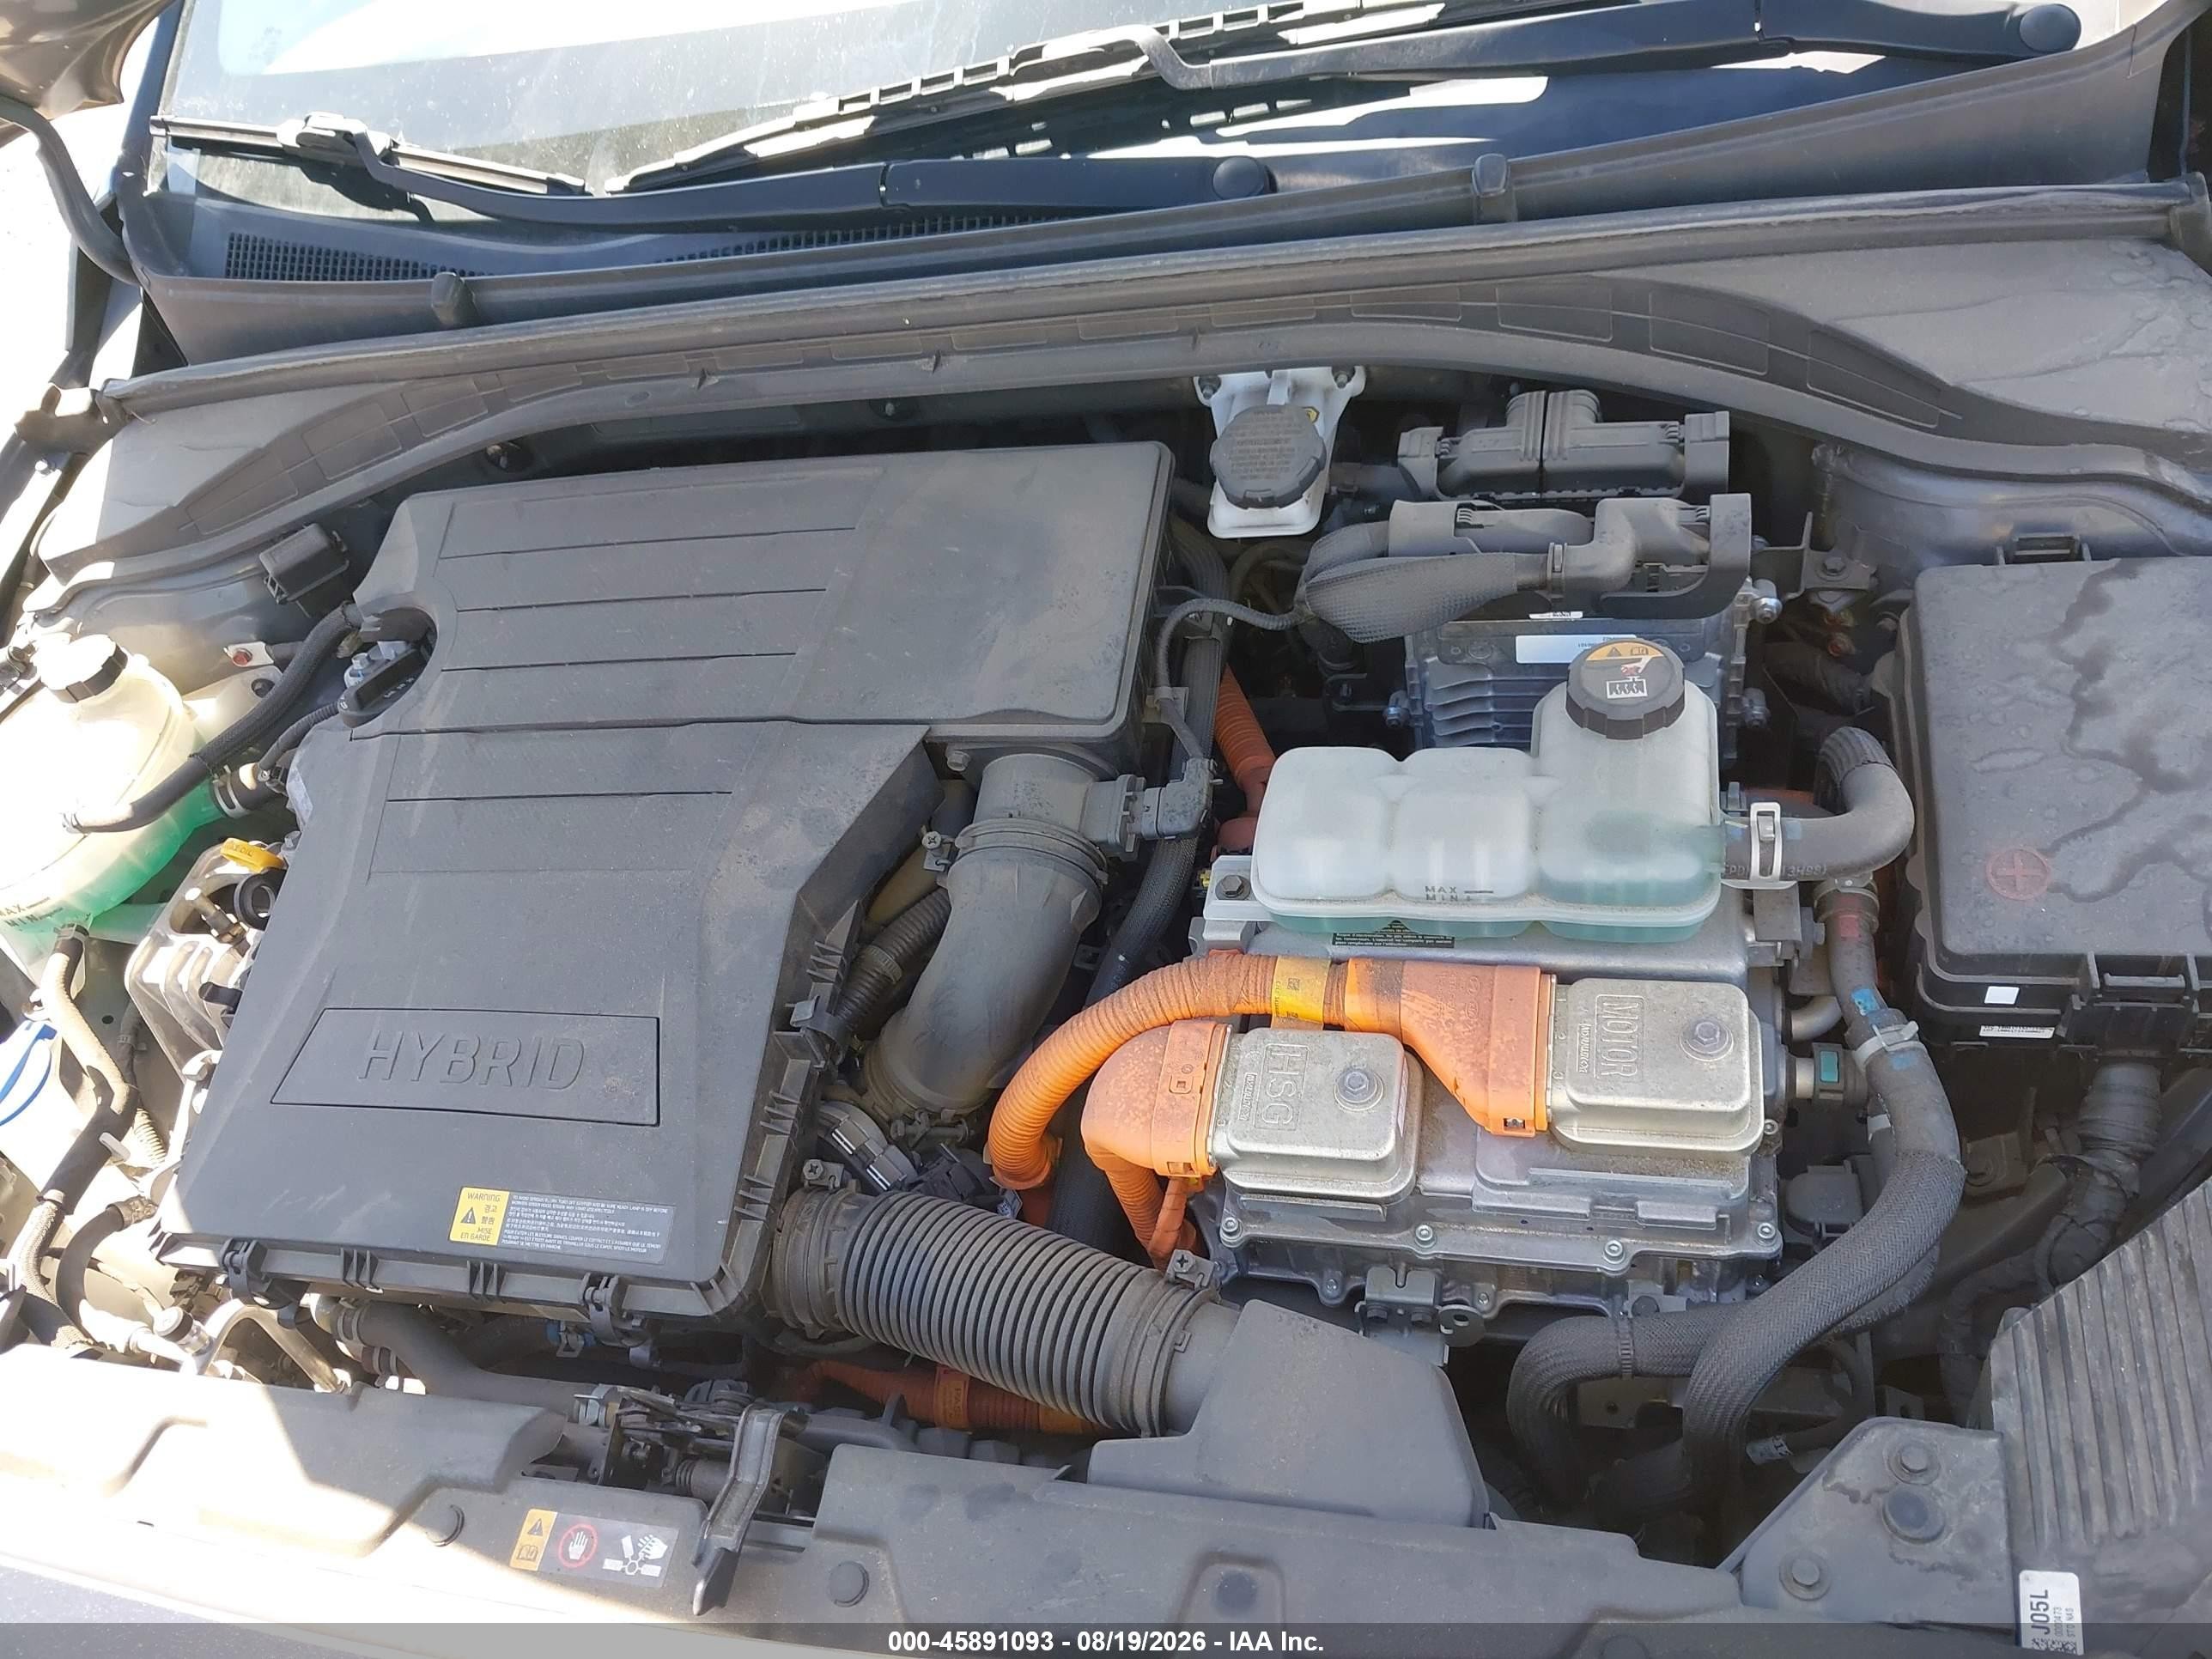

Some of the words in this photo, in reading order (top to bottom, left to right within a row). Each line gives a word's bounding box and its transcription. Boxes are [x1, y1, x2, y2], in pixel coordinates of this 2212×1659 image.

[1425, 885, 1457, 894] MAX
[5, 914, 39, 927] MIN
[1601, 1001, 1639, 1078] MOTOR
[357, 1030, 586, 1091] HYBRID
[1262, 1049, 1299, 1126] HSG
[467, 1192, 501, 1202] WARNING
[483, 1204, 497, 1213] 경고
[470, 1233, 491, 1242] GARDE
[2029, 1589, 2051, 1635] J05L
